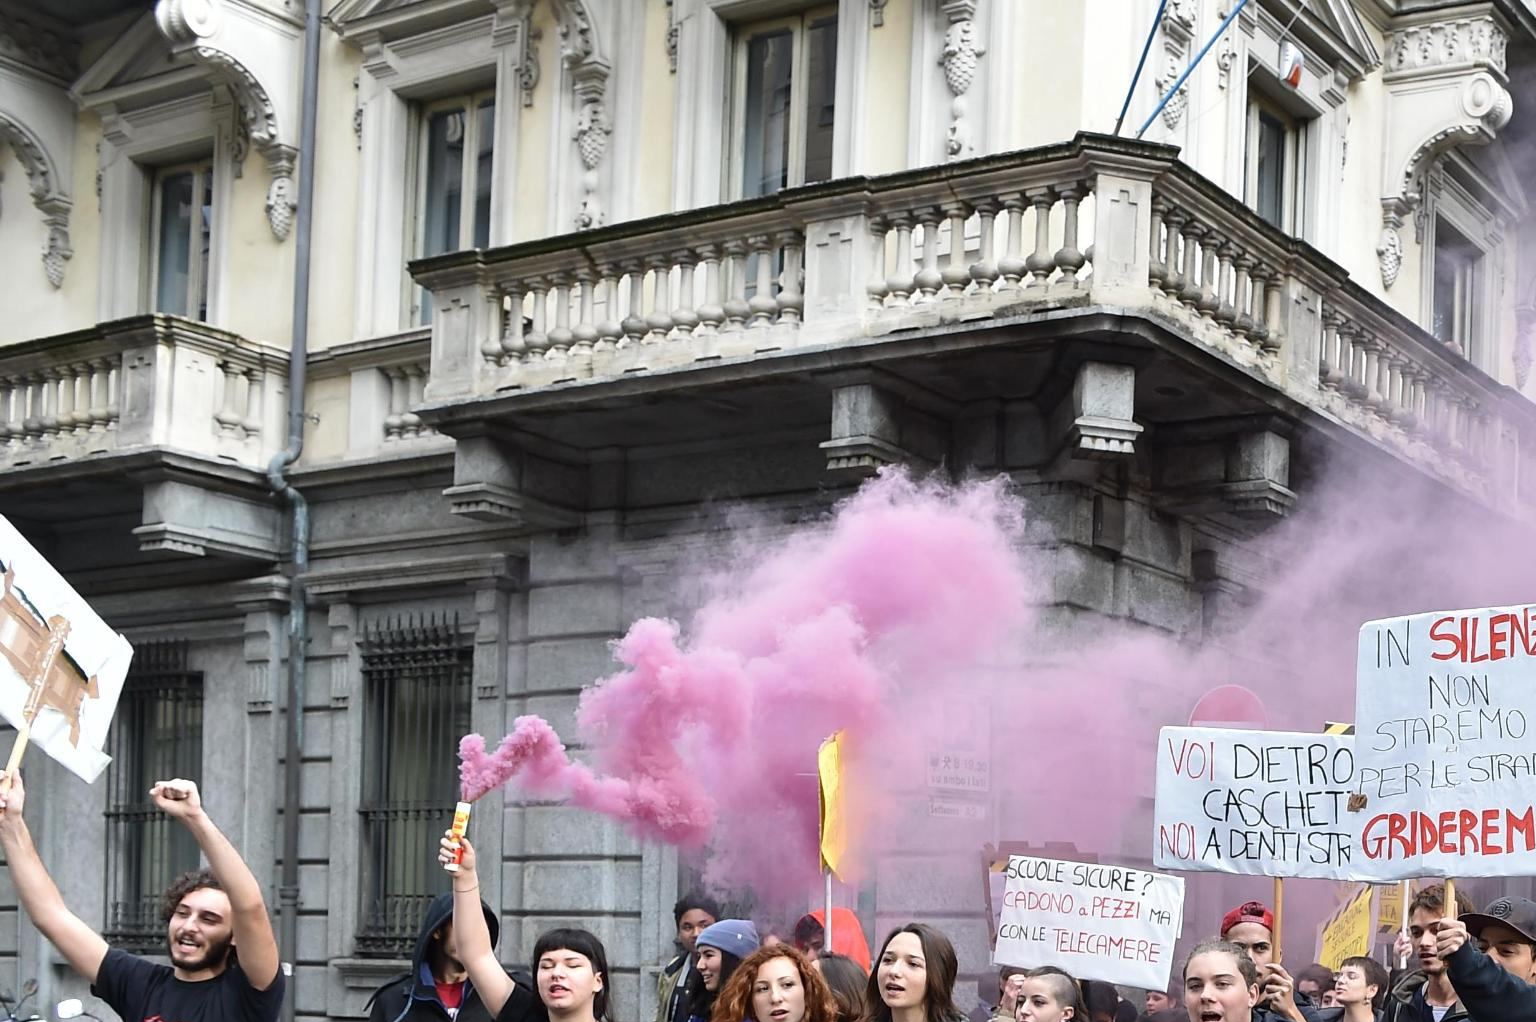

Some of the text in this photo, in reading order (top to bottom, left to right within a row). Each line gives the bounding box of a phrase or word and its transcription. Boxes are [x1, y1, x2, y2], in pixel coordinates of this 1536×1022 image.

[1377, 619, 1410, 668] IN
[1429, 674, 1490, 709] NON
[1372, 708, 1526, 751] STAREMO
[1168, 738, 1354, 785] VOI DIETRO
[1360, 763, 1421, 798] PER
[1430, 760, 1461, 789] LE
[1203, 788, 1353, 829] CASCHET
[1160, 822, 1196, 861] NOI
[1202, 827, 1221, 860] A
[1230, 829, 1301, 864] DENTI
[1008, 859, 1066, 883] SCUOLE
[1073, 865, 1136, 892] SICURE
[1003, 891, 1171, 926] CADONO a PEZZI MA
[1000, 923, 1161, 963] CON LE TELECAMERE
